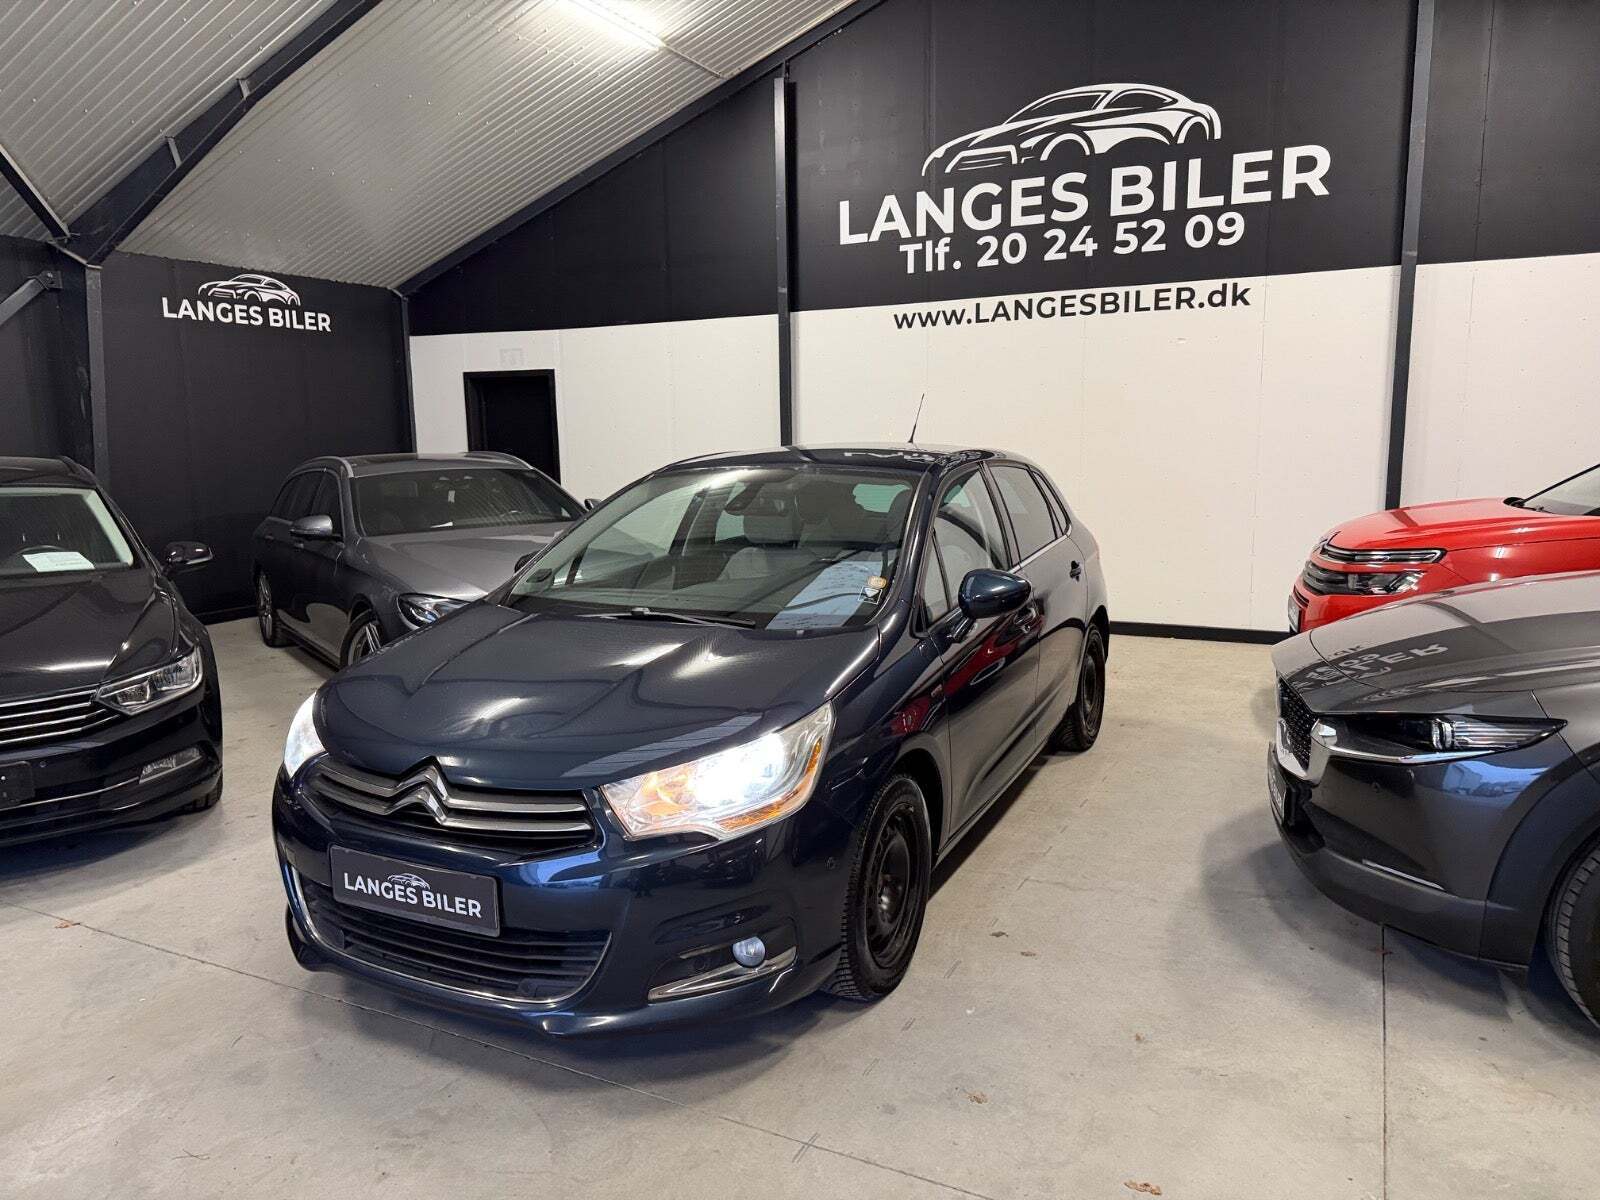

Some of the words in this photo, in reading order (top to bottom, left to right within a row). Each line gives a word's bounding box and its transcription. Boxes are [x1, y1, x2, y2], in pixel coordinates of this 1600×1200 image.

[839, 171, 1090, 246] LANGES
[1109, 144, 1332, 217] BILER
[899, 236, 962, 274] Tlf.
[976, 232, 1028, 268] 20
[1043, 225, 1099, 262] 24
[1113, 218, 1167, 255] 52
[1184, 211, 1245, 249] 09
[161, 296, 264, 326] LANGES
[268, 307, 332, 333] BILER
[893, 282, 1251, 330] www.LANGESBILER.dk
[343, 872, 419, 905] LANGES
[421, 890, 483, 919] BILER
